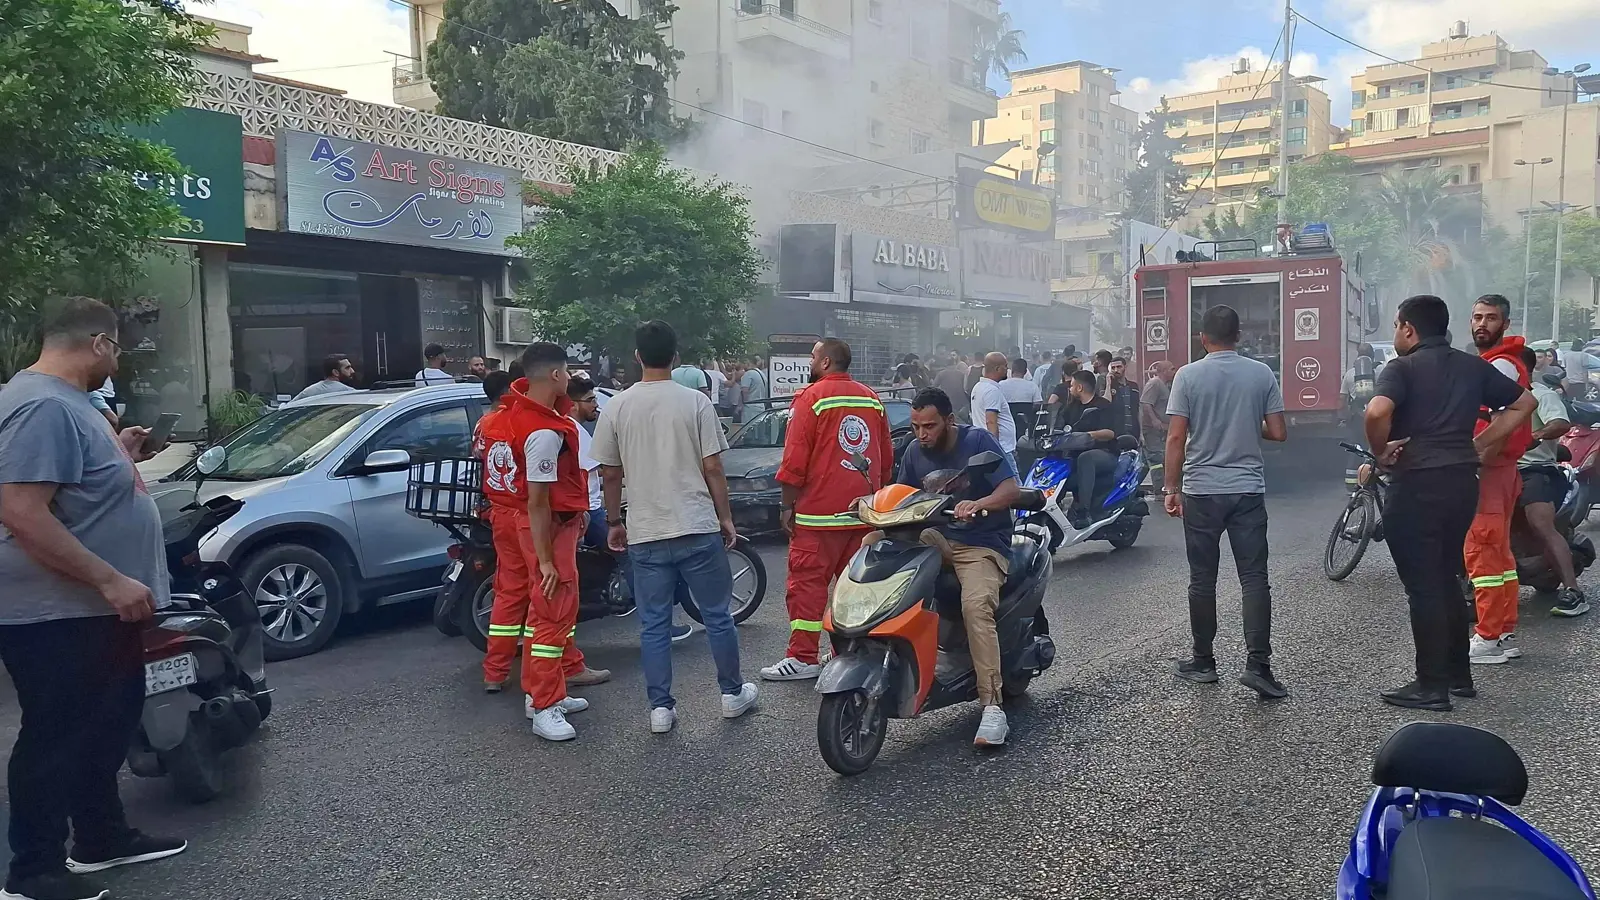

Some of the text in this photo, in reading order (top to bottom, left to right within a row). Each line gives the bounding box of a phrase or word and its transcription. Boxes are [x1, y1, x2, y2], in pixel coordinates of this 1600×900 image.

[361, 149, 505, 204] Art Signs
[429, 187, 449, 199] Signs
[474, 194, 505, 209] Printing
[874, 239, 949, 271] AL BABA
[1288, 267, 1329, 281] الدفاع
[1289, 284, 1330, 299] المدني
[1300, 362, 1318, 370] صيدا
[1301, 370, 1316, 378] ١٢٥
